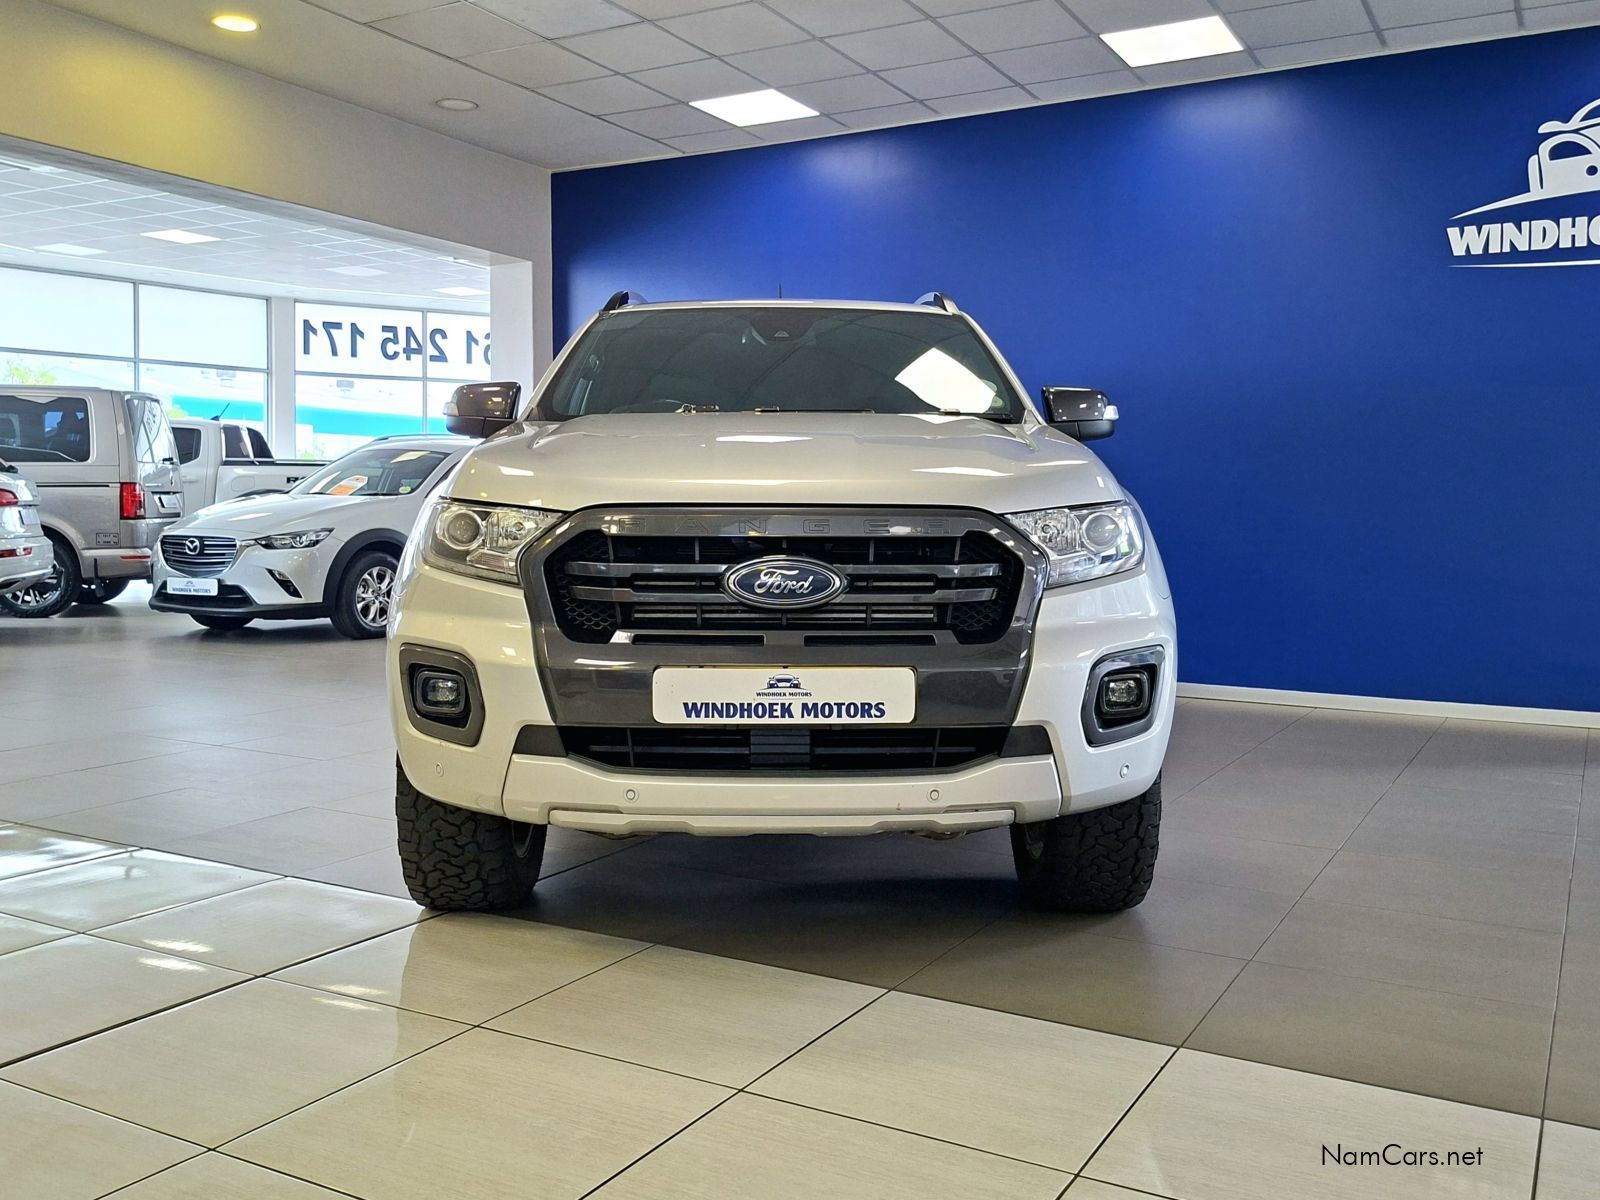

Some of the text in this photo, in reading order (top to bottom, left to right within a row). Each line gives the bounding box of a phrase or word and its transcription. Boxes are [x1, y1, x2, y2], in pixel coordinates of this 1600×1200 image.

[618, 518, 950, 535] RANGER
[754, 568, 814, 594] Ford
[683, 702, 886, 719] WINDHOEK MOTORS
